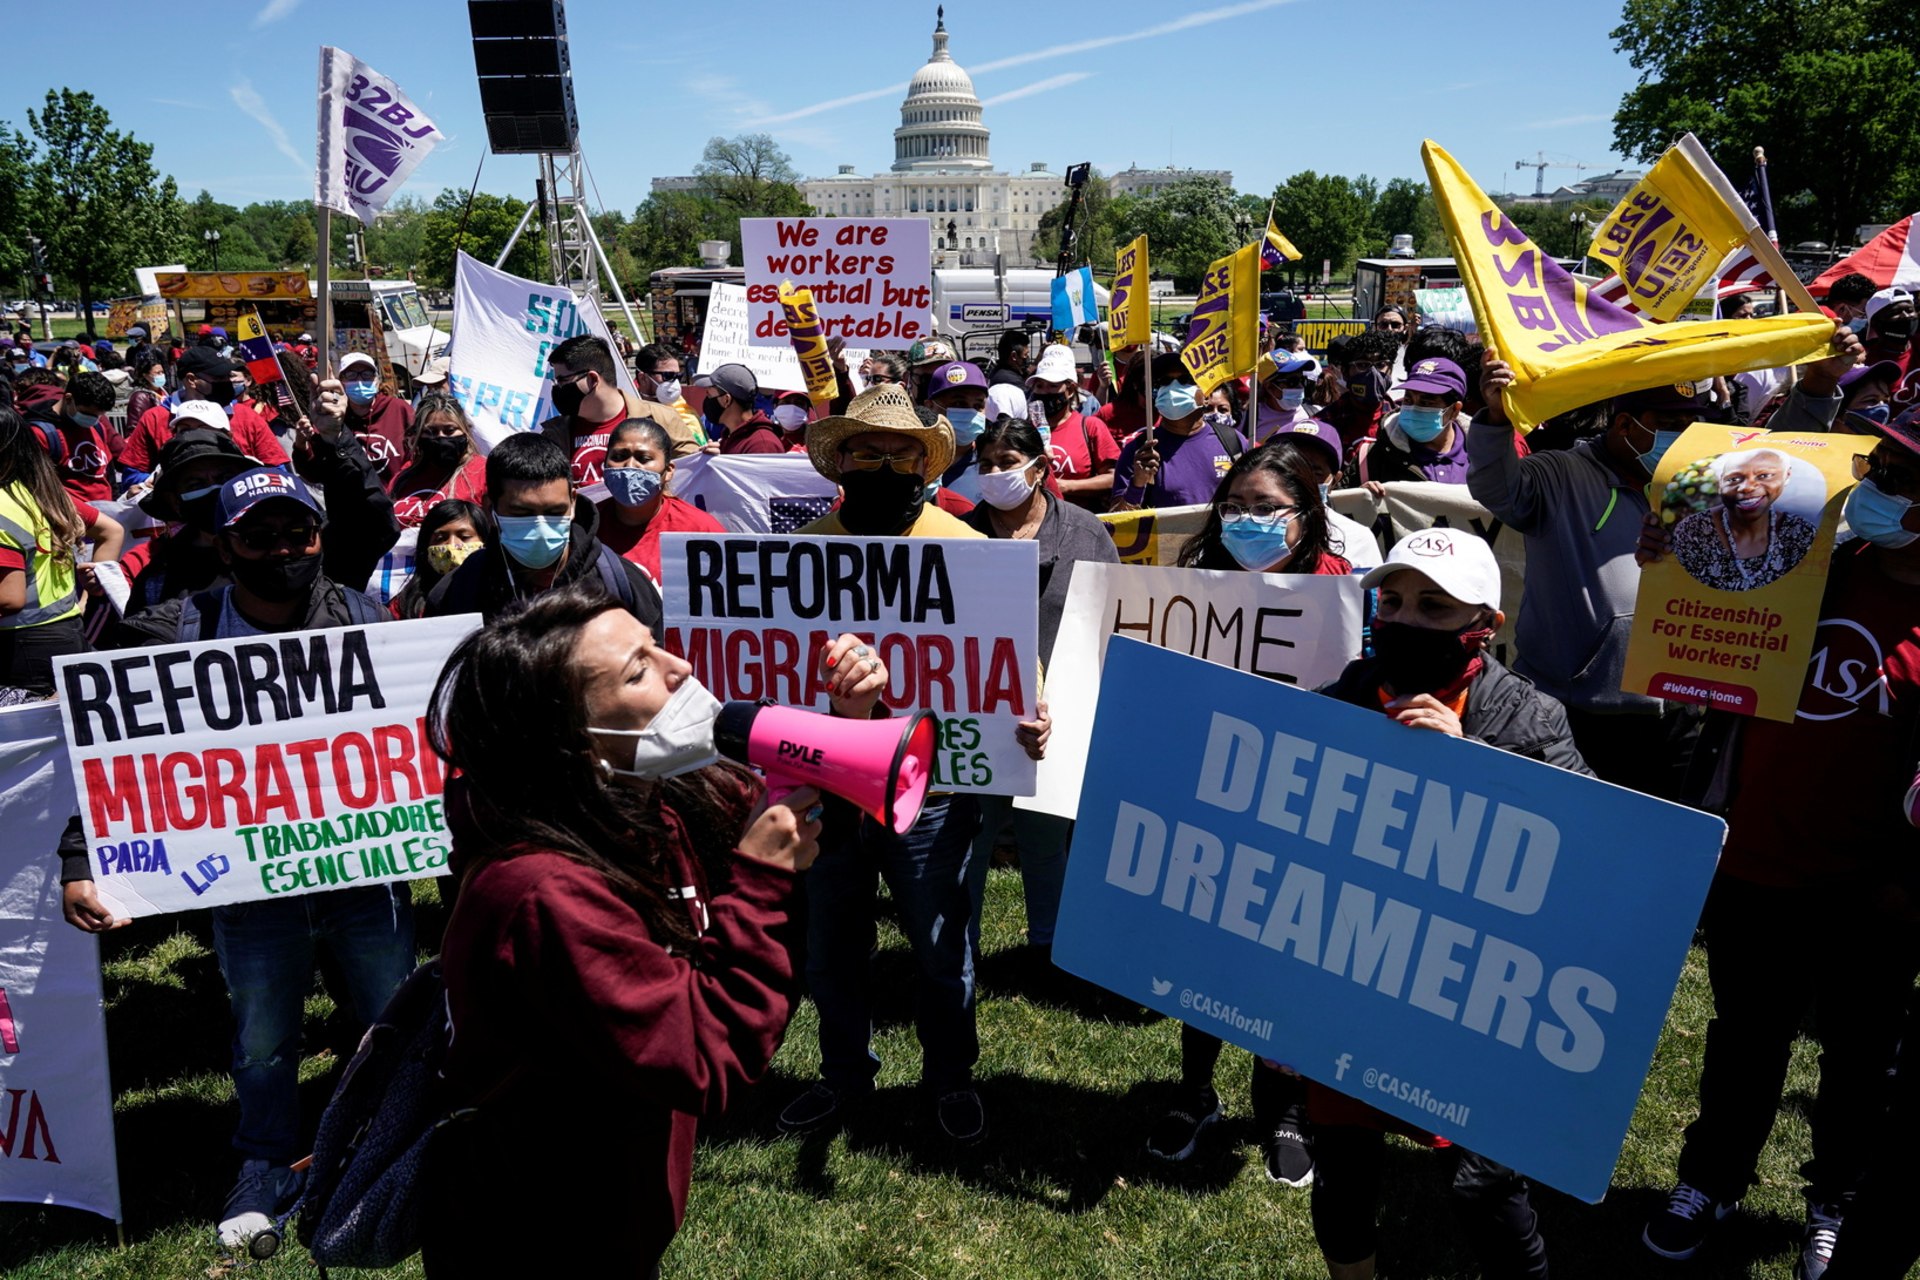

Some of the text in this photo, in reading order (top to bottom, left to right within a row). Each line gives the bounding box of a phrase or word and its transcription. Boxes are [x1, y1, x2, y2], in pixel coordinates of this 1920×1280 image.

[345, 74, 435, 139] 32BJ
[344, 160, 388, 194] EIU
[776, 220, 888, 247] We are
[767, 249, 895, 275] workers
[747, 278, 930, 309] esntial but
[756, 311, 928, 339] dertable.
[232, 473, 296, 497] BIDEN
[249, 486, 287, 498] HARRIS
[1407, 537, 1455, 556] CASA
[685, 539, 956, 625] REFORMA
[1114, 596, 1303, 683] HOME
[1651, 619, 1789, 653] For Essential
[1665, 598, 1783, 632] Citizenship
[663, 626, 1025, 717] MIGRAORIA
[1667, 642, 1761, 672] Workers!
[1809, 646, 1893, 718] ASA
[62, 630, 386, 746] REFORMA
[82, 716, 463, 838] MIGRATORI
[778, 739, 826, 766] PYLE
[235, 798, 446, 863] TRABAJADORE
[1195, 711, 1561, 916] DEFEND
[96, 837, 231, 897] PARA LOS
[259, 837, 450, 895] ESENCIALES
[1104, 800, 1618, 1074] DREAMERS
[1179, 988, 1274, 1041] @CASAforAll
[1362, 1067, 1471, 1128] @CASAforAll
